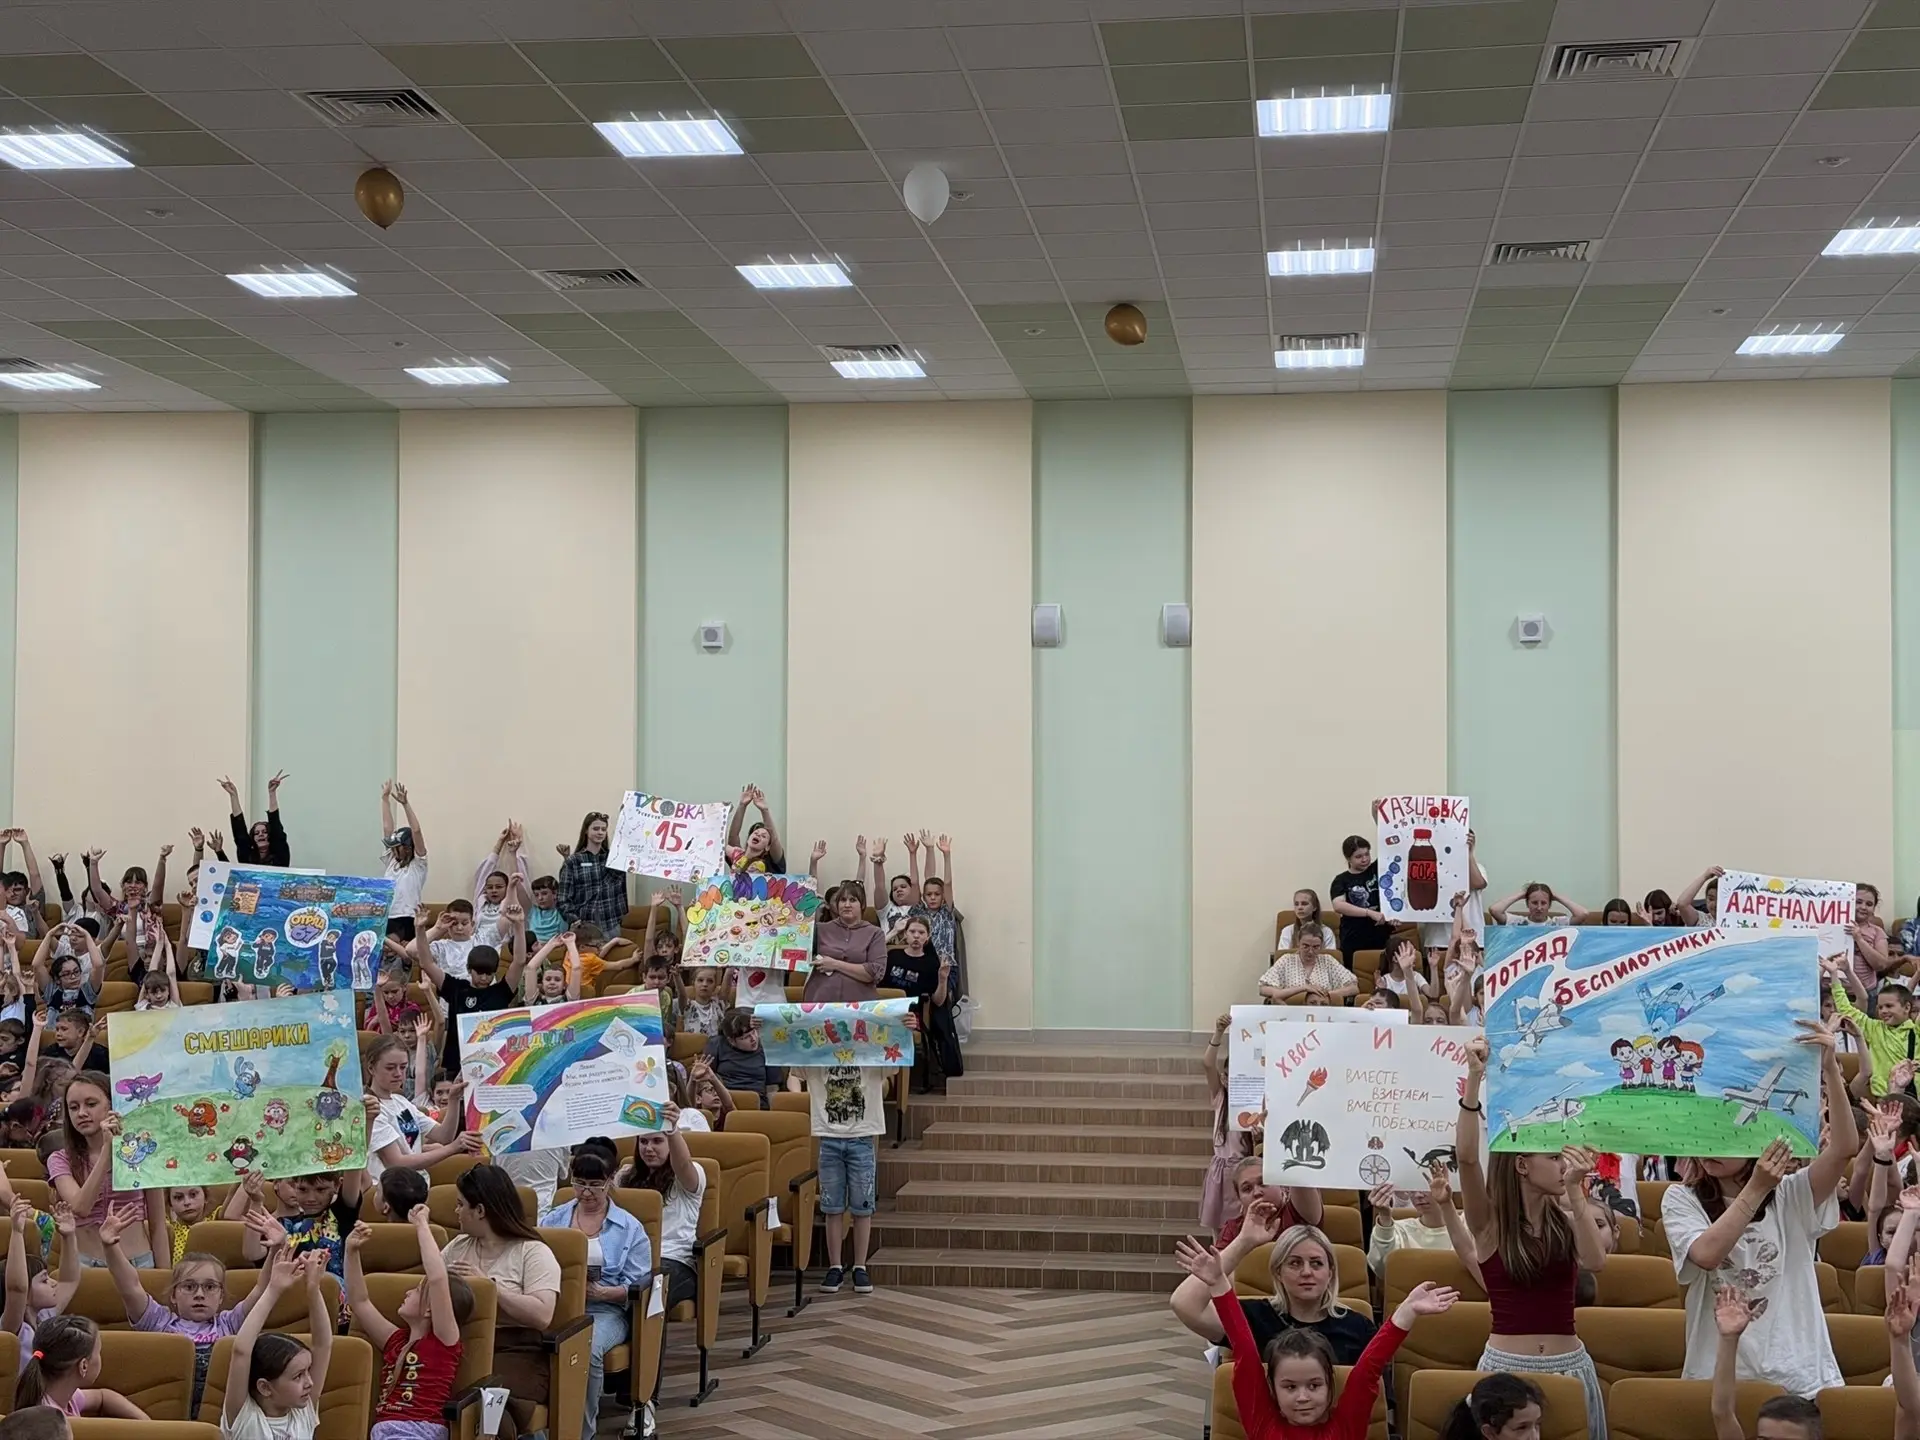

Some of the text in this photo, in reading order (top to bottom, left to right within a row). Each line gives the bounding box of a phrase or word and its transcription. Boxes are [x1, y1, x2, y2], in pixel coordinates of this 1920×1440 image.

[634, 792, 706, 820] ТУСОВКА
[655, 820, 687, 852] 15
[1725, 891, 1850, 925] АДРЕНАЛИН
[290, 924, 321, 944] 67
[184, 1022, 310, 1055] СМЕШАРИКИ
[1275, 1029, 1321, 1078] ХВОСТ
[1373, 1026, 1393, 1050] И
[1430, 1036, 1468, 1066] КРЫ
[1346, 1068, 1400, 1085] ВМЕСТЕ
[1347, 1099, 1400, 1115] ВМЕСТЕ
